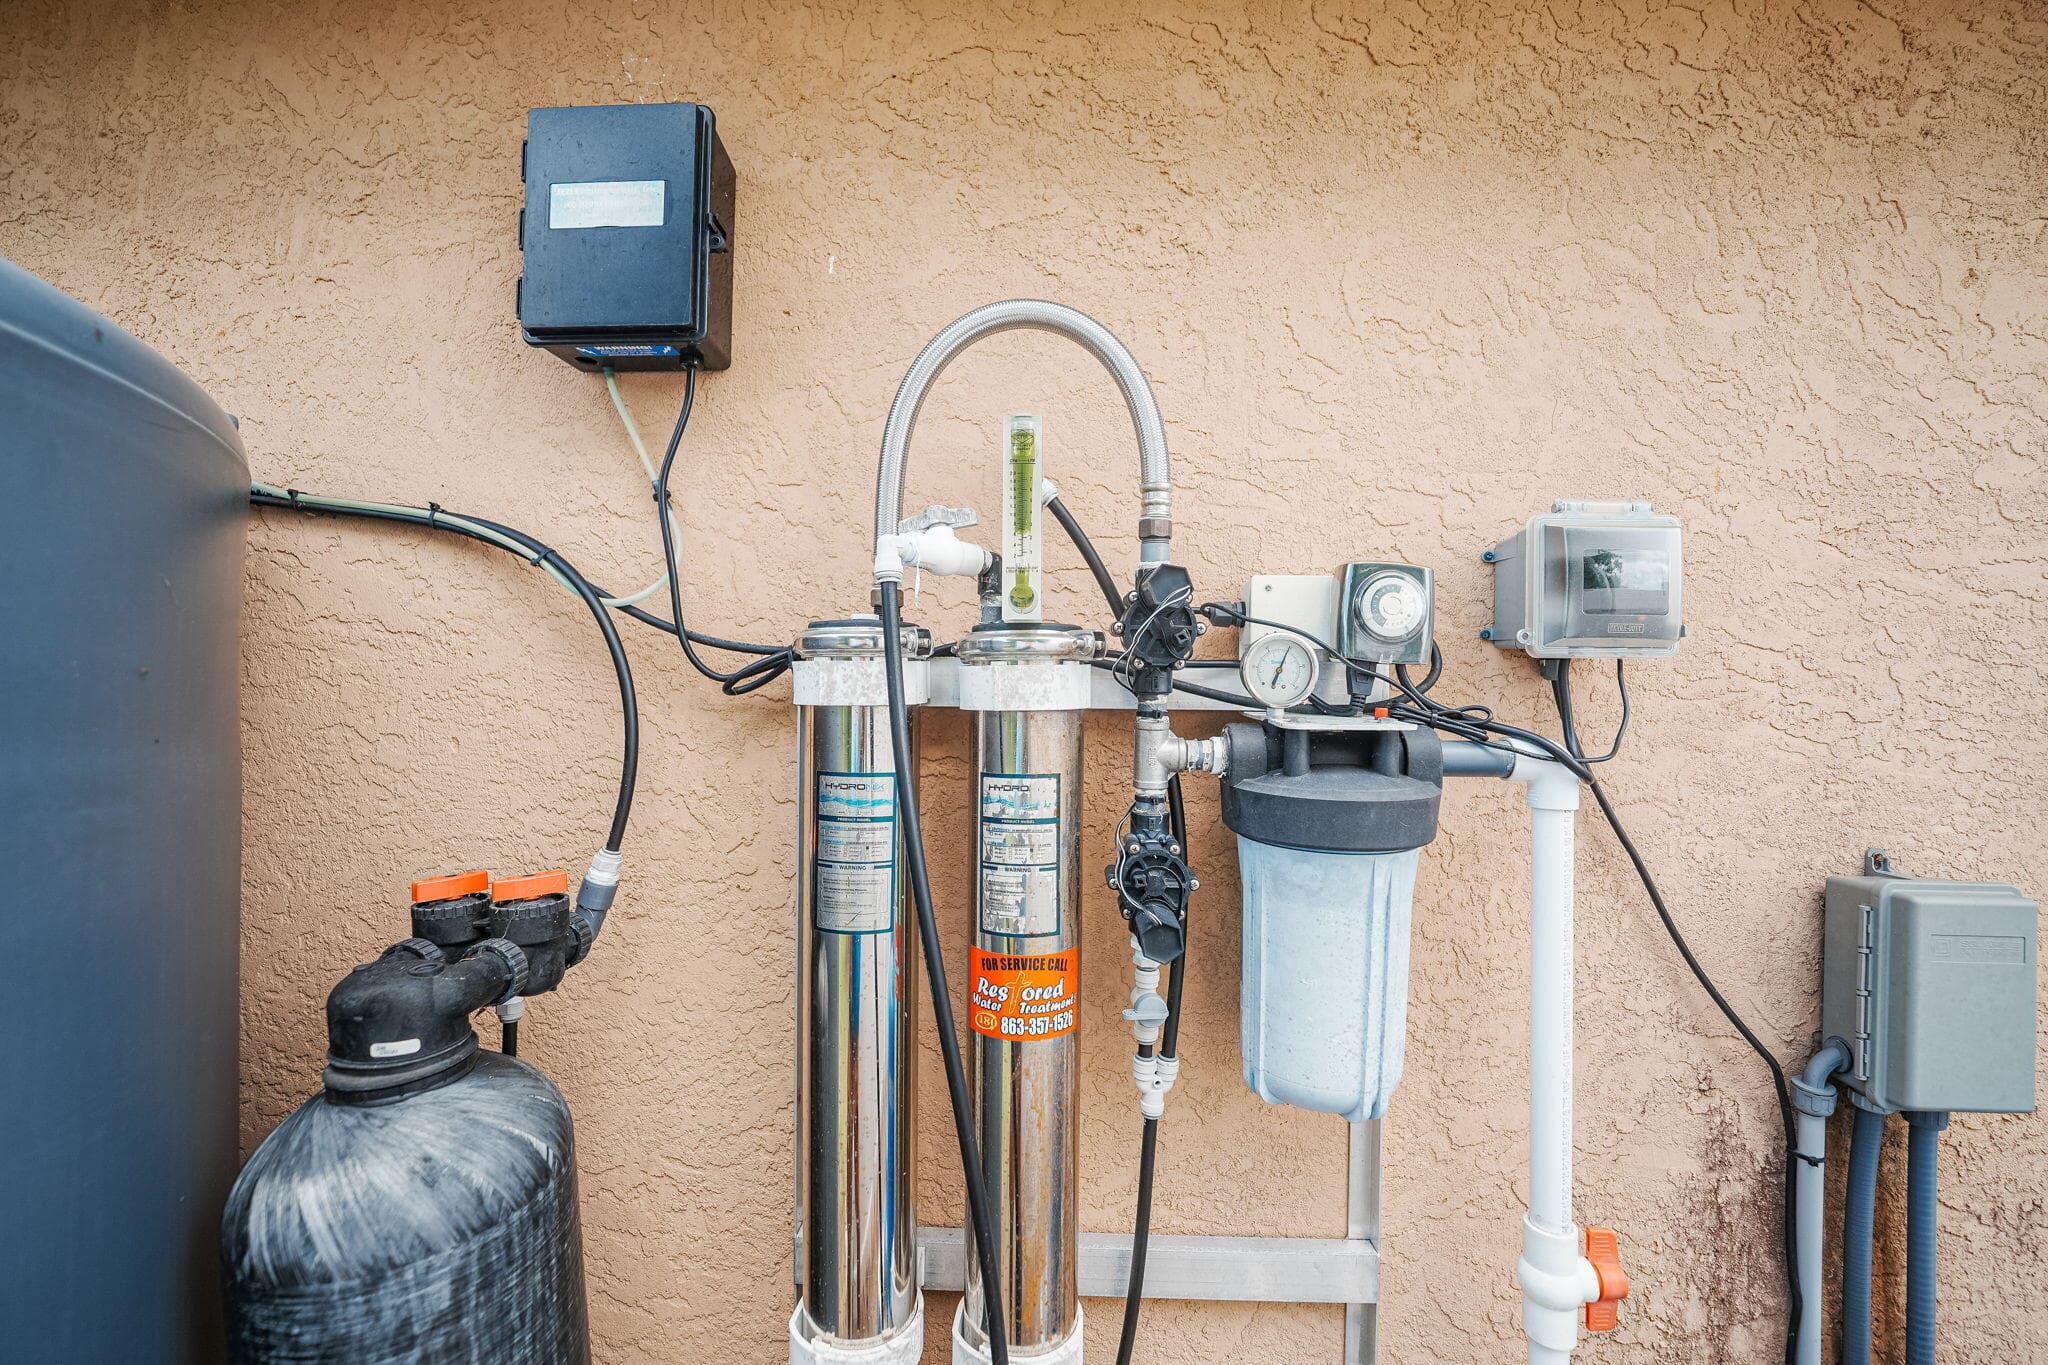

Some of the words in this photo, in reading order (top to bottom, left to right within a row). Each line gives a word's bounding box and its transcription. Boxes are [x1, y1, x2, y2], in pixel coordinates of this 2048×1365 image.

[981, 957, 999, 971] FOR
[1000, 957, 1046, 971] SERVICE
[1047, 957, 1068, 972] CALL
[973, 992, 1002, 1012] Water
[1000, 1009, 1073, 1036] 863-357-1526
